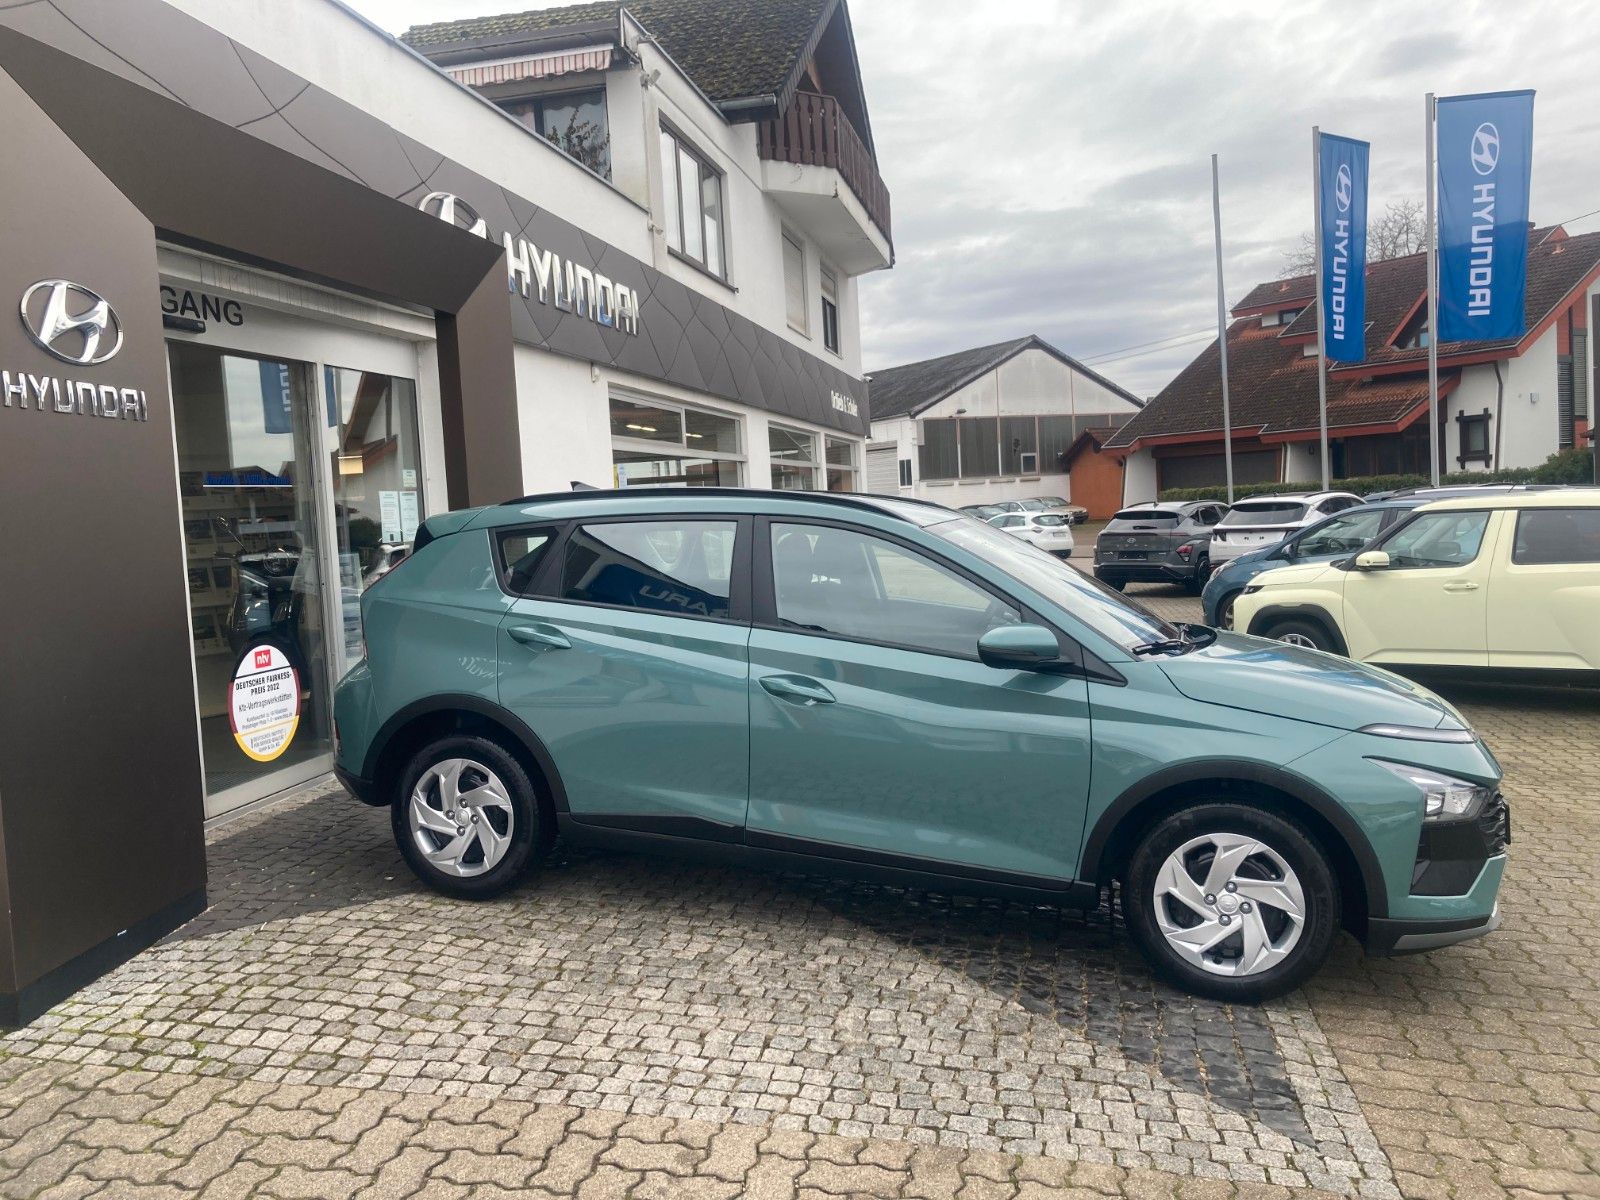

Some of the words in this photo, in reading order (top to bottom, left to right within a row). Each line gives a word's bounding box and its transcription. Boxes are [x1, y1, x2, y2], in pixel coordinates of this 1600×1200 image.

[1468, 183, 1495, 316] HYUNDAI
[502, 231, 640, 338] HYUNDAI
[1332, 220, 1349, 340] HYUNDAI
[1, 370, 148, 422] HYUNDAI
[235, 677, 265, 690] DEUTSCHER
[257, 653, 270, 664] ntv
[250, 685, 266, 696] PREIS
[266, 683, 280, 692] 2022
